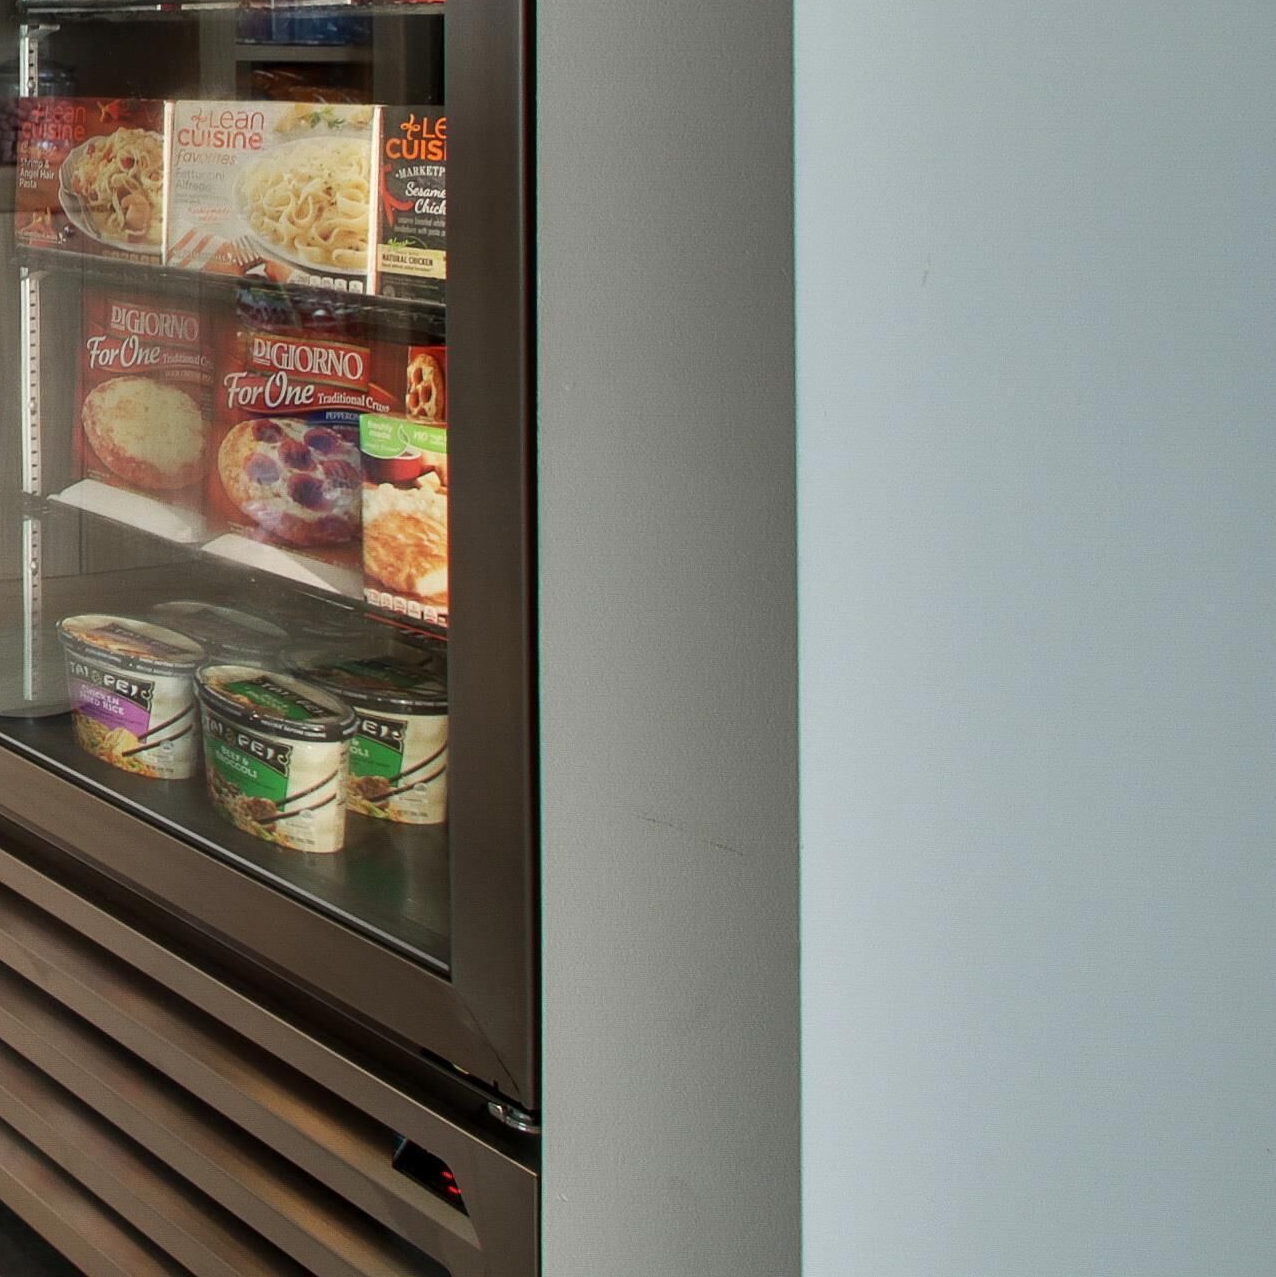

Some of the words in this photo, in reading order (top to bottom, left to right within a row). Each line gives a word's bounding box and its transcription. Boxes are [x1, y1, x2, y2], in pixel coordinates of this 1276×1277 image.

[386, 138, 447, 161] CUIS
[19, 167, 39, 178] Angel
[398, 165, 446, 179] MARKETP
[19, 179, 37, 189] Pasta
[405, 181, 446, 199] Sesame
[414, 198, 446, 216] Chick
[87, 335, 120, 369] For
[120, 335, 161, 367] One
[224, 371, 264, 409] For
[264, 371, 315, 408] One
[317, 392, 365, 407] Traditional
[326, 412, 359, 421] PEPPERON
[102, 701, 125, 716] RICE
[361, 718, 390, 737] EI
